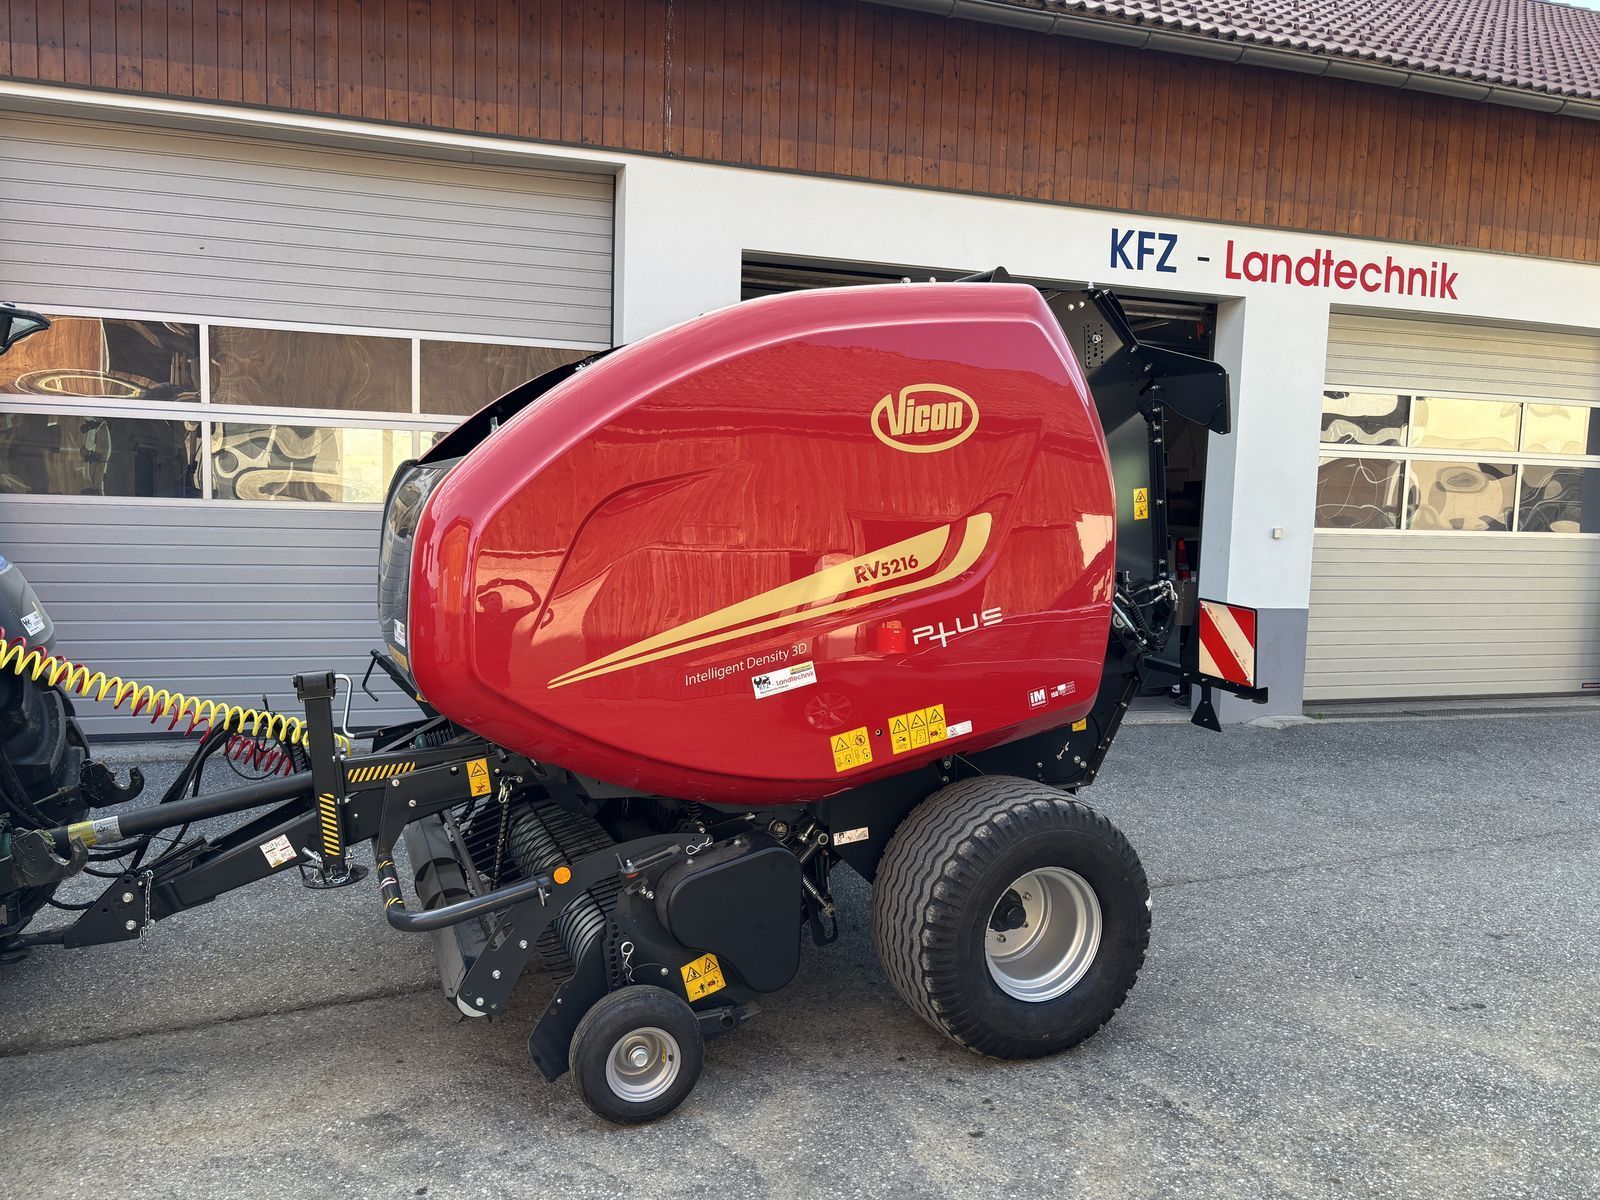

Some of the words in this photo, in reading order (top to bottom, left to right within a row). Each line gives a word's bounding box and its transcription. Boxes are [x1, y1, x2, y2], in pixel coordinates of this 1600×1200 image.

[1110, 228, 1178, 272] KFZ
[1225, 240, 1459, 300] Landtechnik
[880, 391, 963, 436] Vicon
[854, 555, 919, 584] RV5216
[912, 607, 1003, 647] PLUS
[685, 660, 744, 686] Intelligent
[746, 650, 790, 669] Density
[791, 643, 807, 657] 3D
[776, 671, 814, 686] Landtechnik
